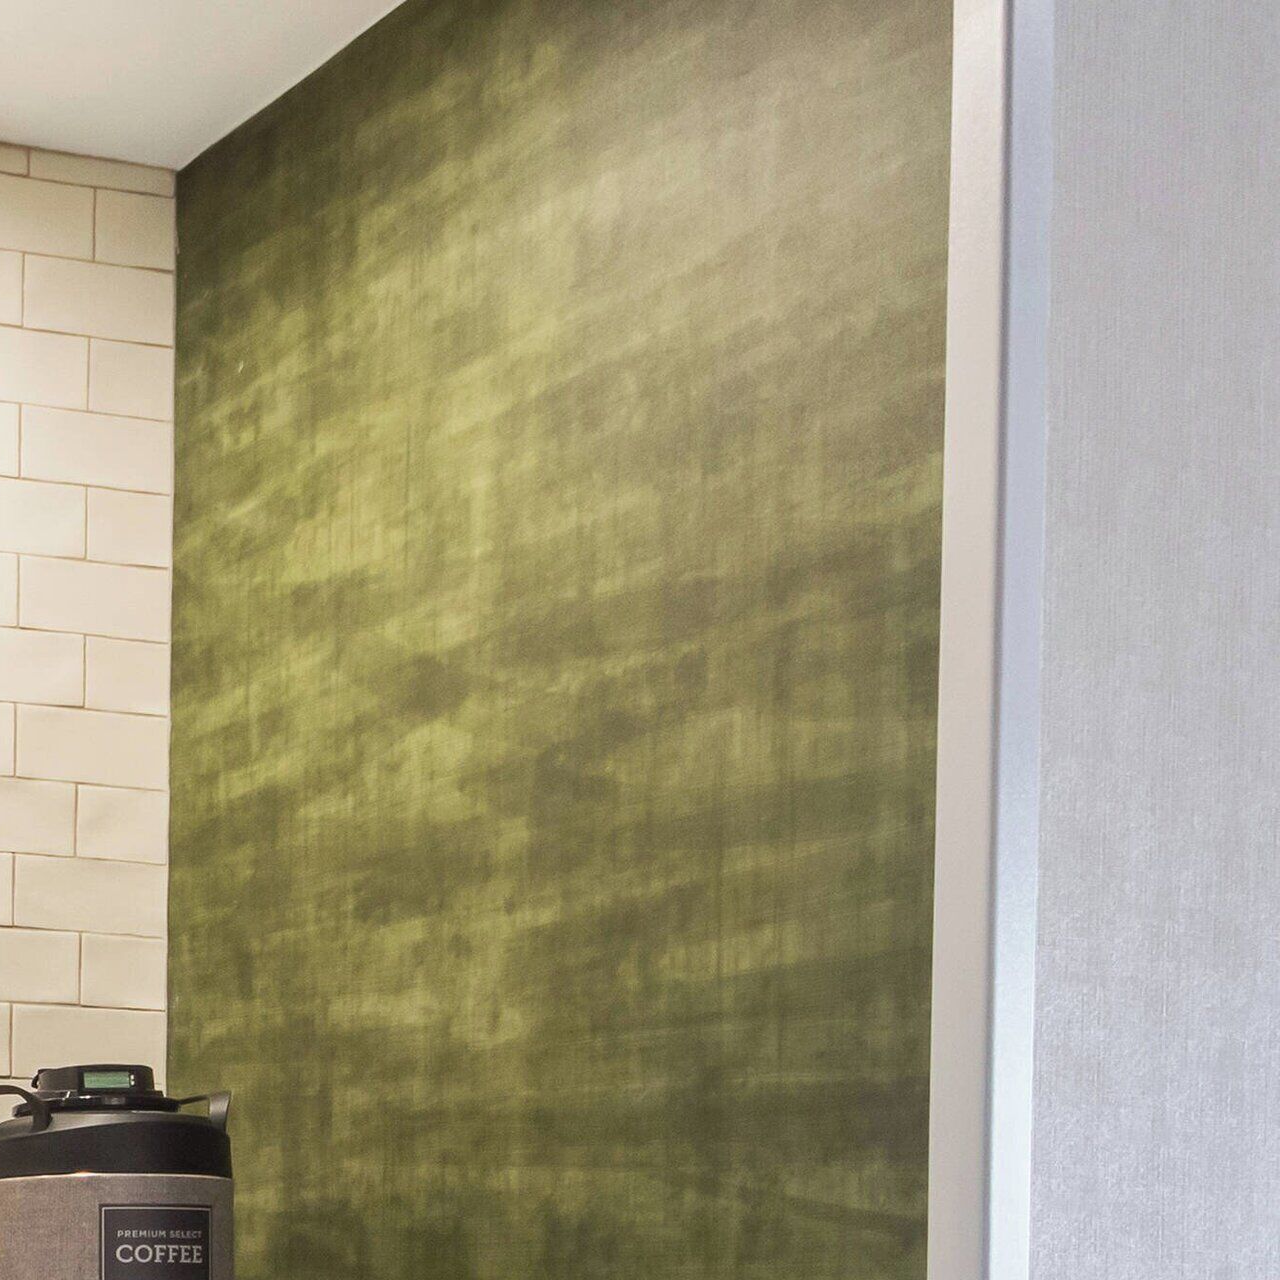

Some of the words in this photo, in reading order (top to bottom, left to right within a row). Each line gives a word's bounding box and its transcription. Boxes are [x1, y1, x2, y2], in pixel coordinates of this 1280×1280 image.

[117, 1229, 167, 1239] PREMIUM
[169, 1230, 203, 1239] SELECT
[115, 1244, 203, 1264] COFFEE
